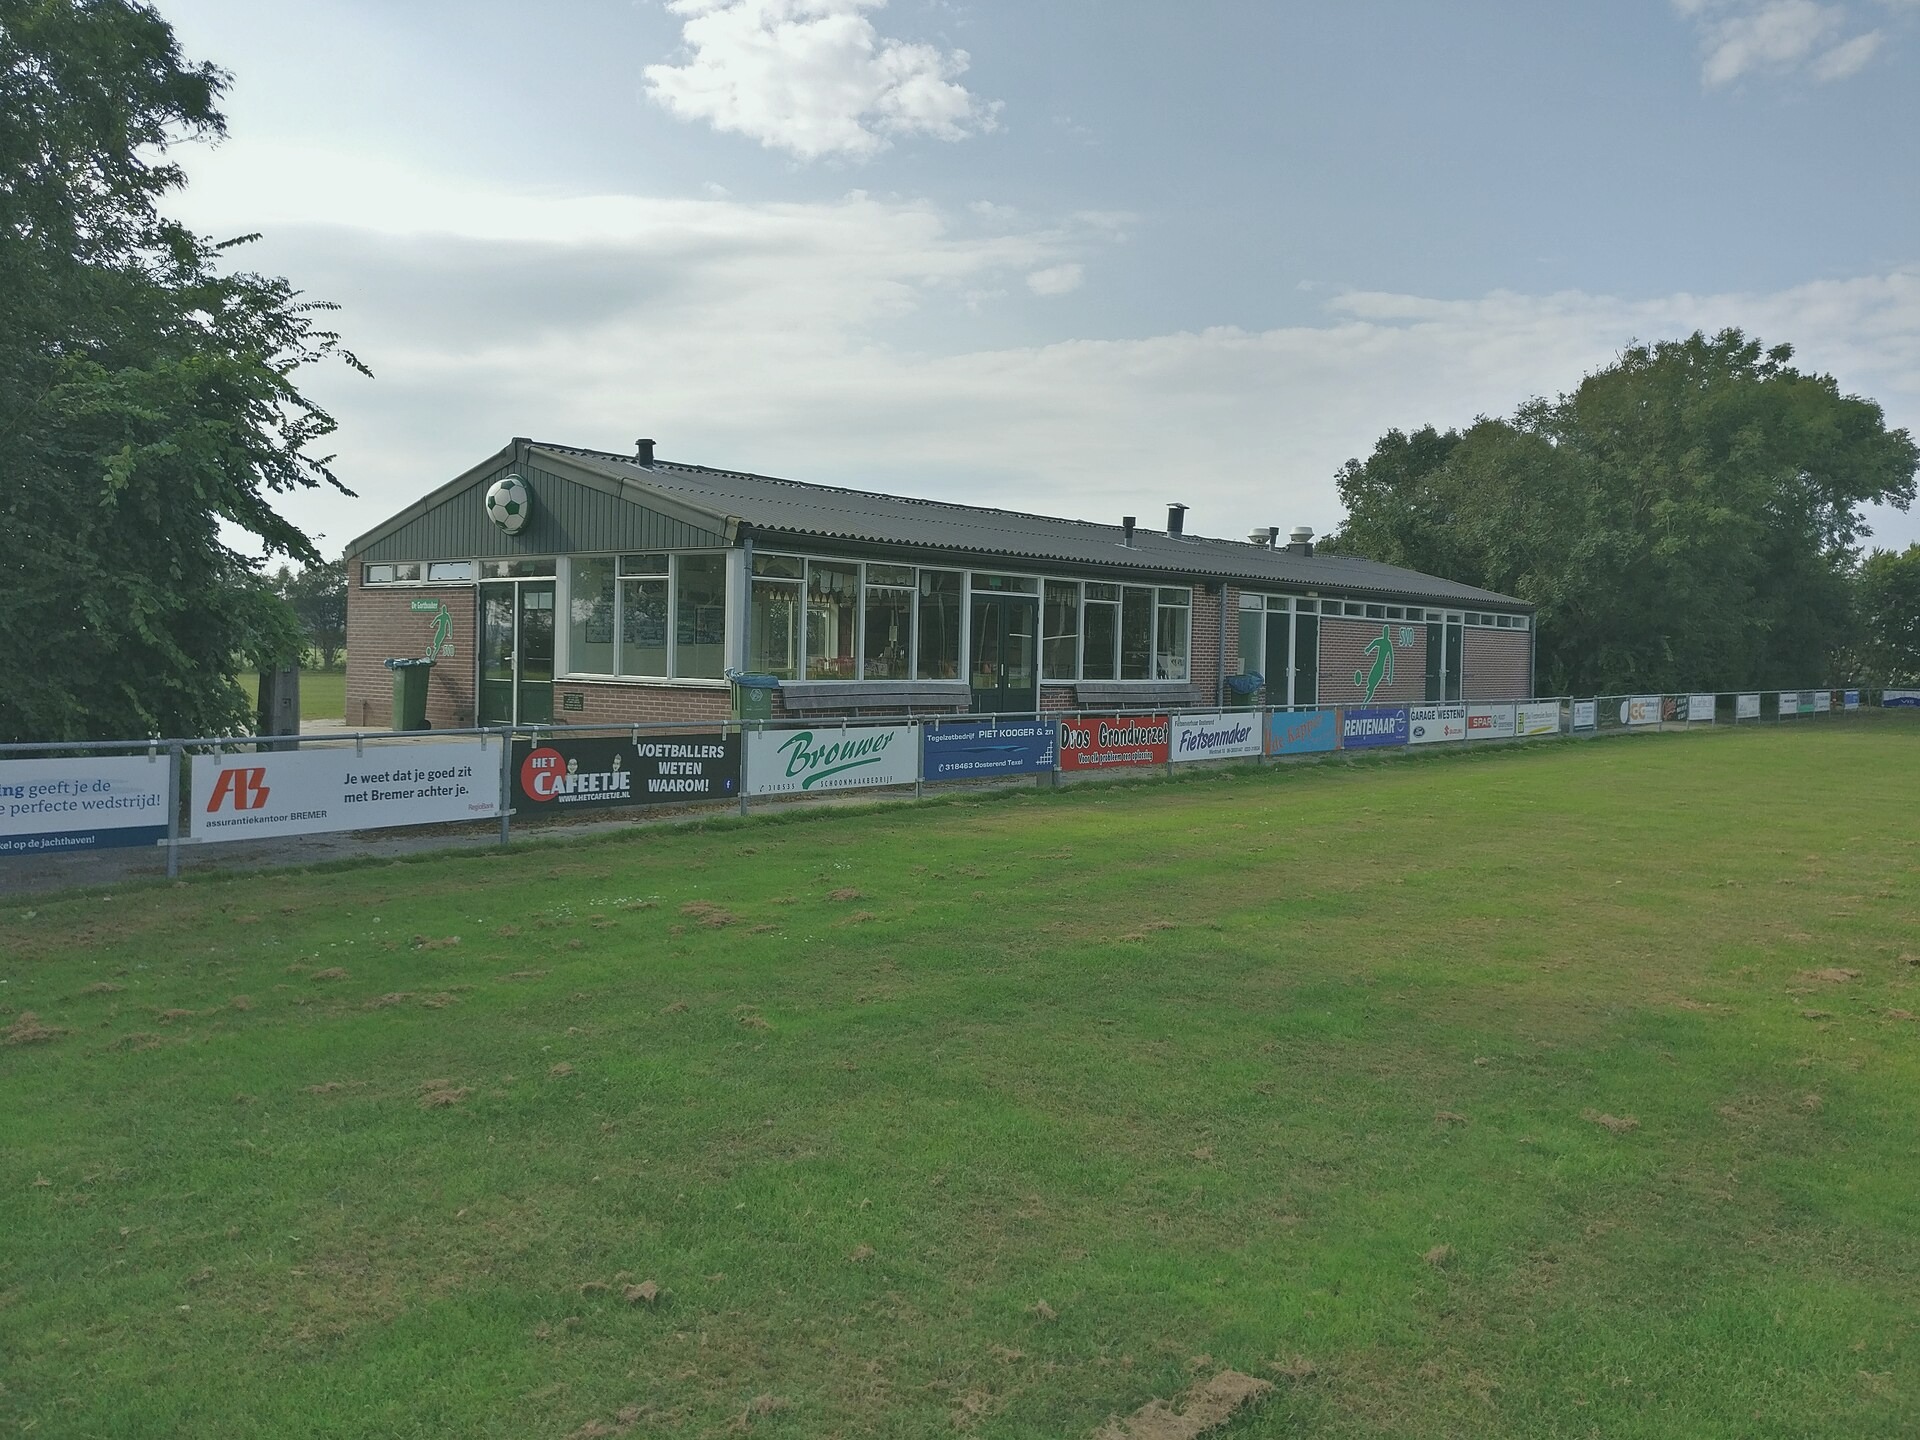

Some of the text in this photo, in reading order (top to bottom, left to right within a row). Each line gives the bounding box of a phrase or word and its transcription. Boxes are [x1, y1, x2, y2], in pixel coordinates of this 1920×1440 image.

[1411, 709, 1465, 721] GARAGE WESTEND
[1473, 717, 1492, 727] SPAR
[978, 729, 998, 739] PIET
[1000, 728, 1034, 738] KOOGER
[1036, 728, 1043, 736] &
[1060, 719, 1169, 750] Dros Grondverzet
[1344, 718, 1396, 737] RENTENAAR
[1179, 722, 1252, 752] Fietsenmaker
[637, 743, 725, 758] VOETBALLERS
[776, 731, 895, 777] Brouwer
[532, 757, 557, 769] HET
[658, 761, 702, 775] WETEN
[945, 763, 973, 771] 318463
[974, 759, 1007, 768] Oosterend
[344, 766, 472, 785] Je weet dat je goed zit
[534, 771, 631, 795] CAFEETJE
[820, 775, 893, 788] SCHOONMAAKBEDRIJF
[28, 781, 70, 799] geeft
[72, 780, 88, 796] je
[92, 779, 111, 793] de
[344, 784, 469, 803] met Bremer achter je.
[648, 779, 709, 792] WAAROM!
[558, 791, 631, 803] WWW.HETCAFEETJE.NL
[10, 799, 78, 817] perfecte
[82, 794, 161, 810] wedstrijd!
[206, 810, 328, 828] assurantiekantoor BREMER
[14, 841, 27, 851] op
[27, 838, 40, 848] de
[40, 835, 95, 849] jachthaven!
